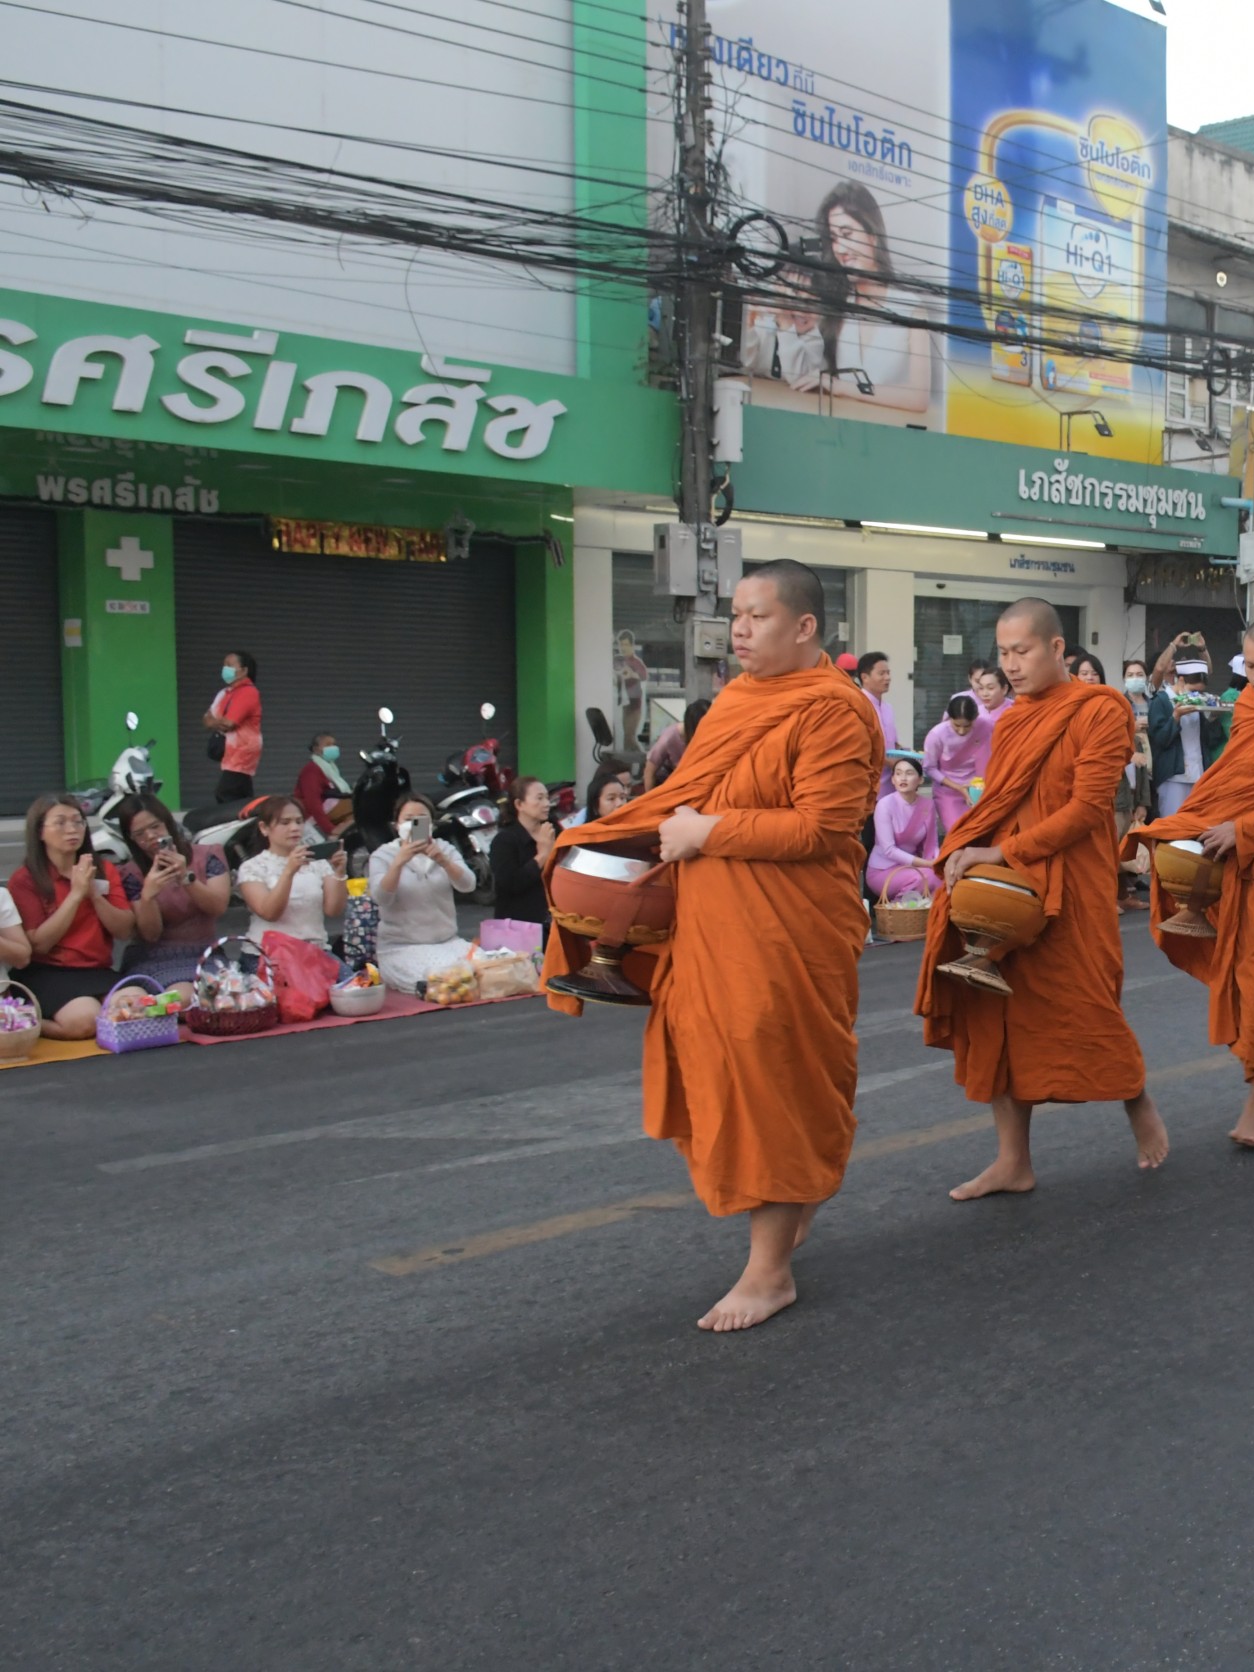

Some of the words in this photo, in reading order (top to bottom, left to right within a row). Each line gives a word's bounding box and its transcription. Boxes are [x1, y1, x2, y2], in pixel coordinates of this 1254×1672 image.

[791, 99, 912, 169] ซินไบโอติก
[1079, 136, 1151, 180] ซินไบโอติก
[974, 184, 1004, 208] DHA
[1066, 242, 1112, 275] Hi-Q1
[36, 472, 220, 514] พรศรีเภสัช
[1018, 458, 1206, 529] เภสัชกรรมชุมชน
